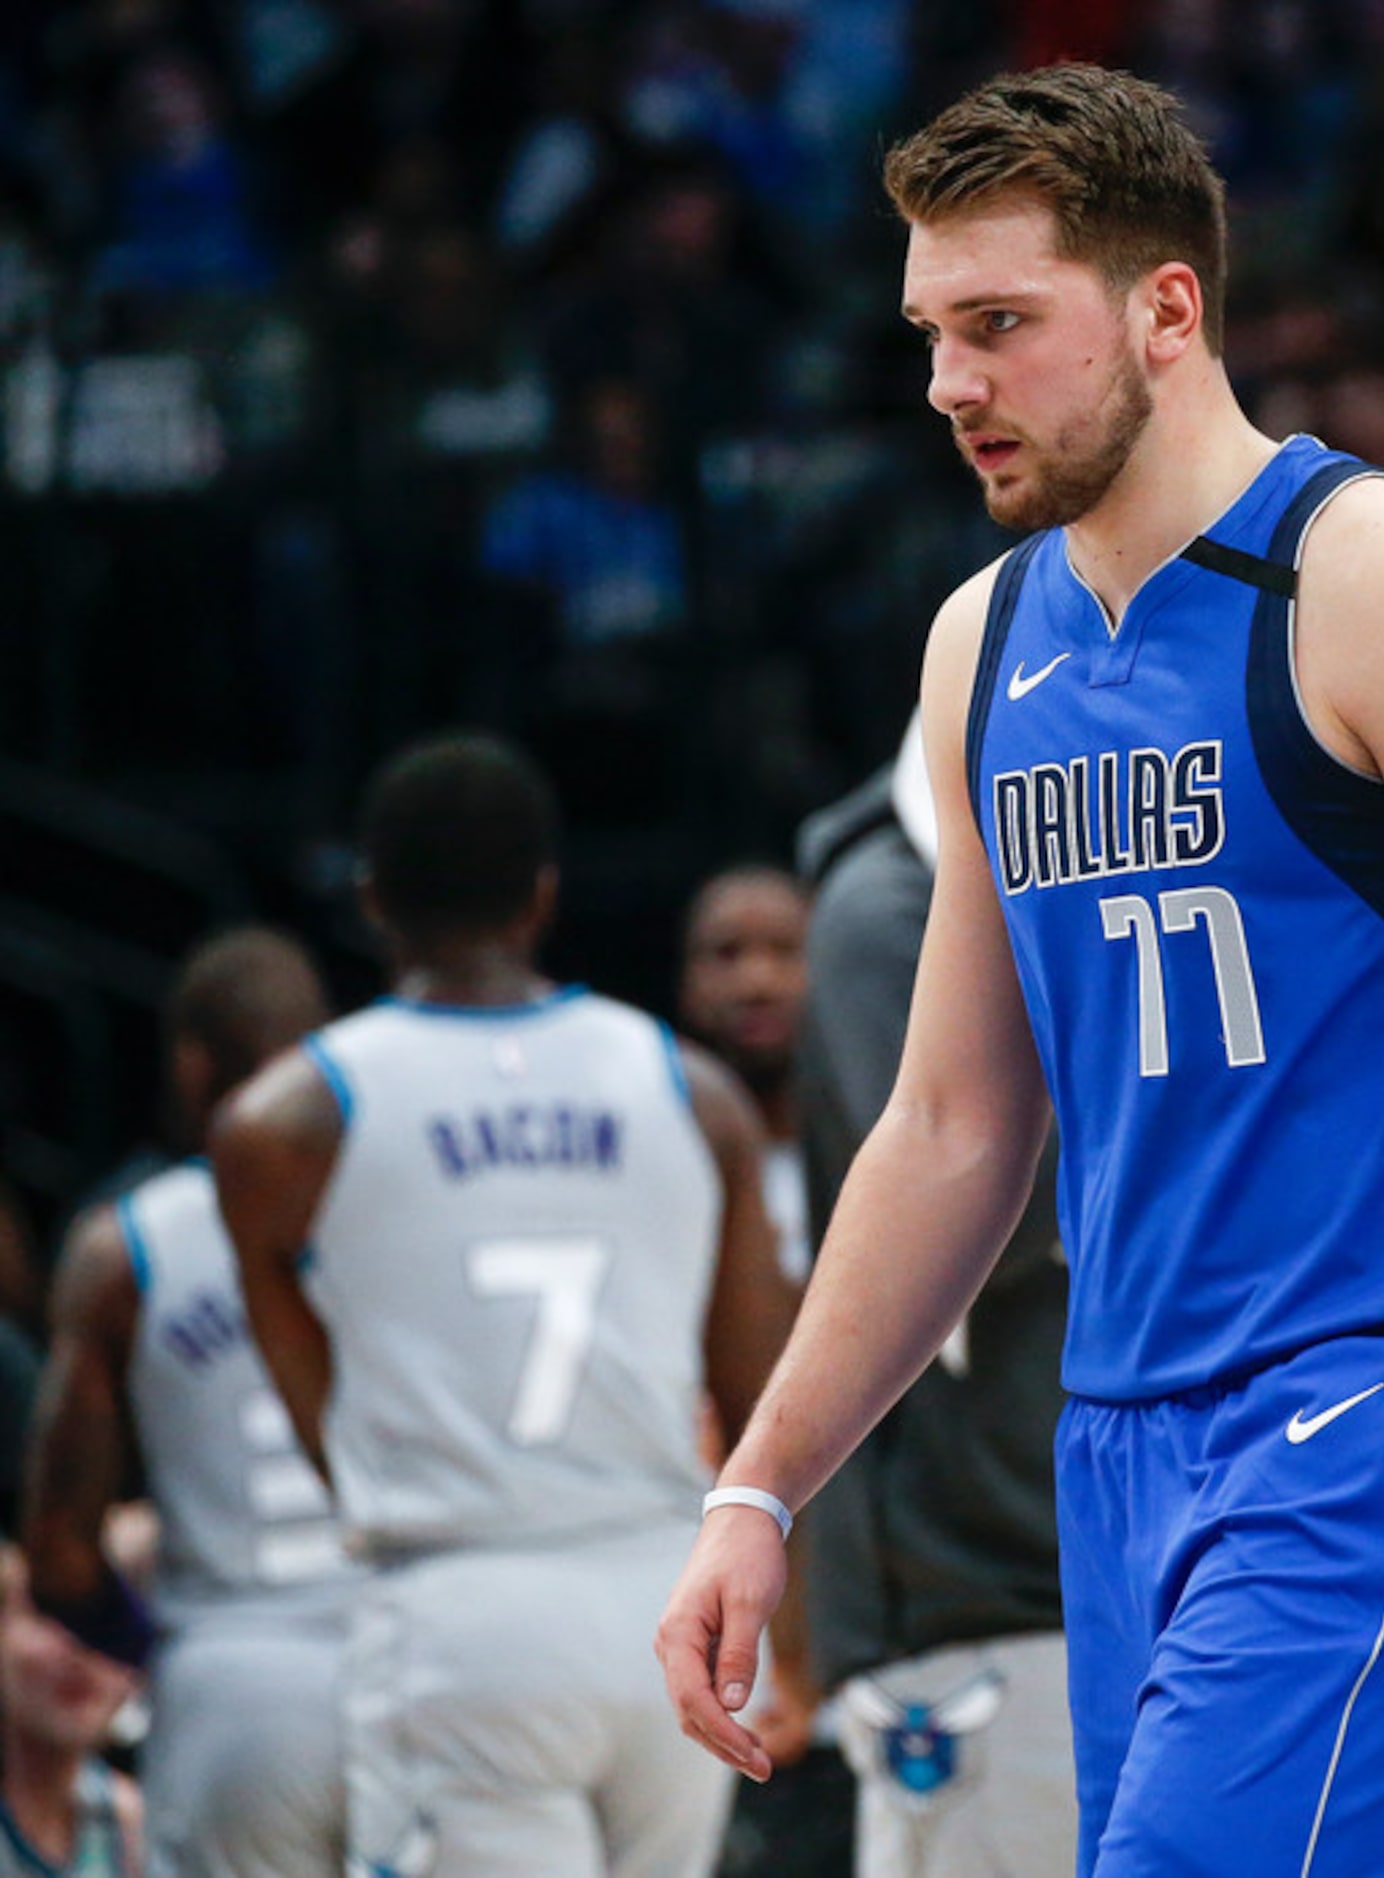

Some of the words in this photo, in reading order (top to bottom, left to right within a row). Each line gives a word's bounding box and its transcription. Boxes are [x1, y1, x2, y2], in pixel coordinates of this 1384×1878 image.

[993, 739, 1225, 896] DALLAS
[1098, 886, 1266, 1077] 77
[465, 1238, 606, 1448] 7
